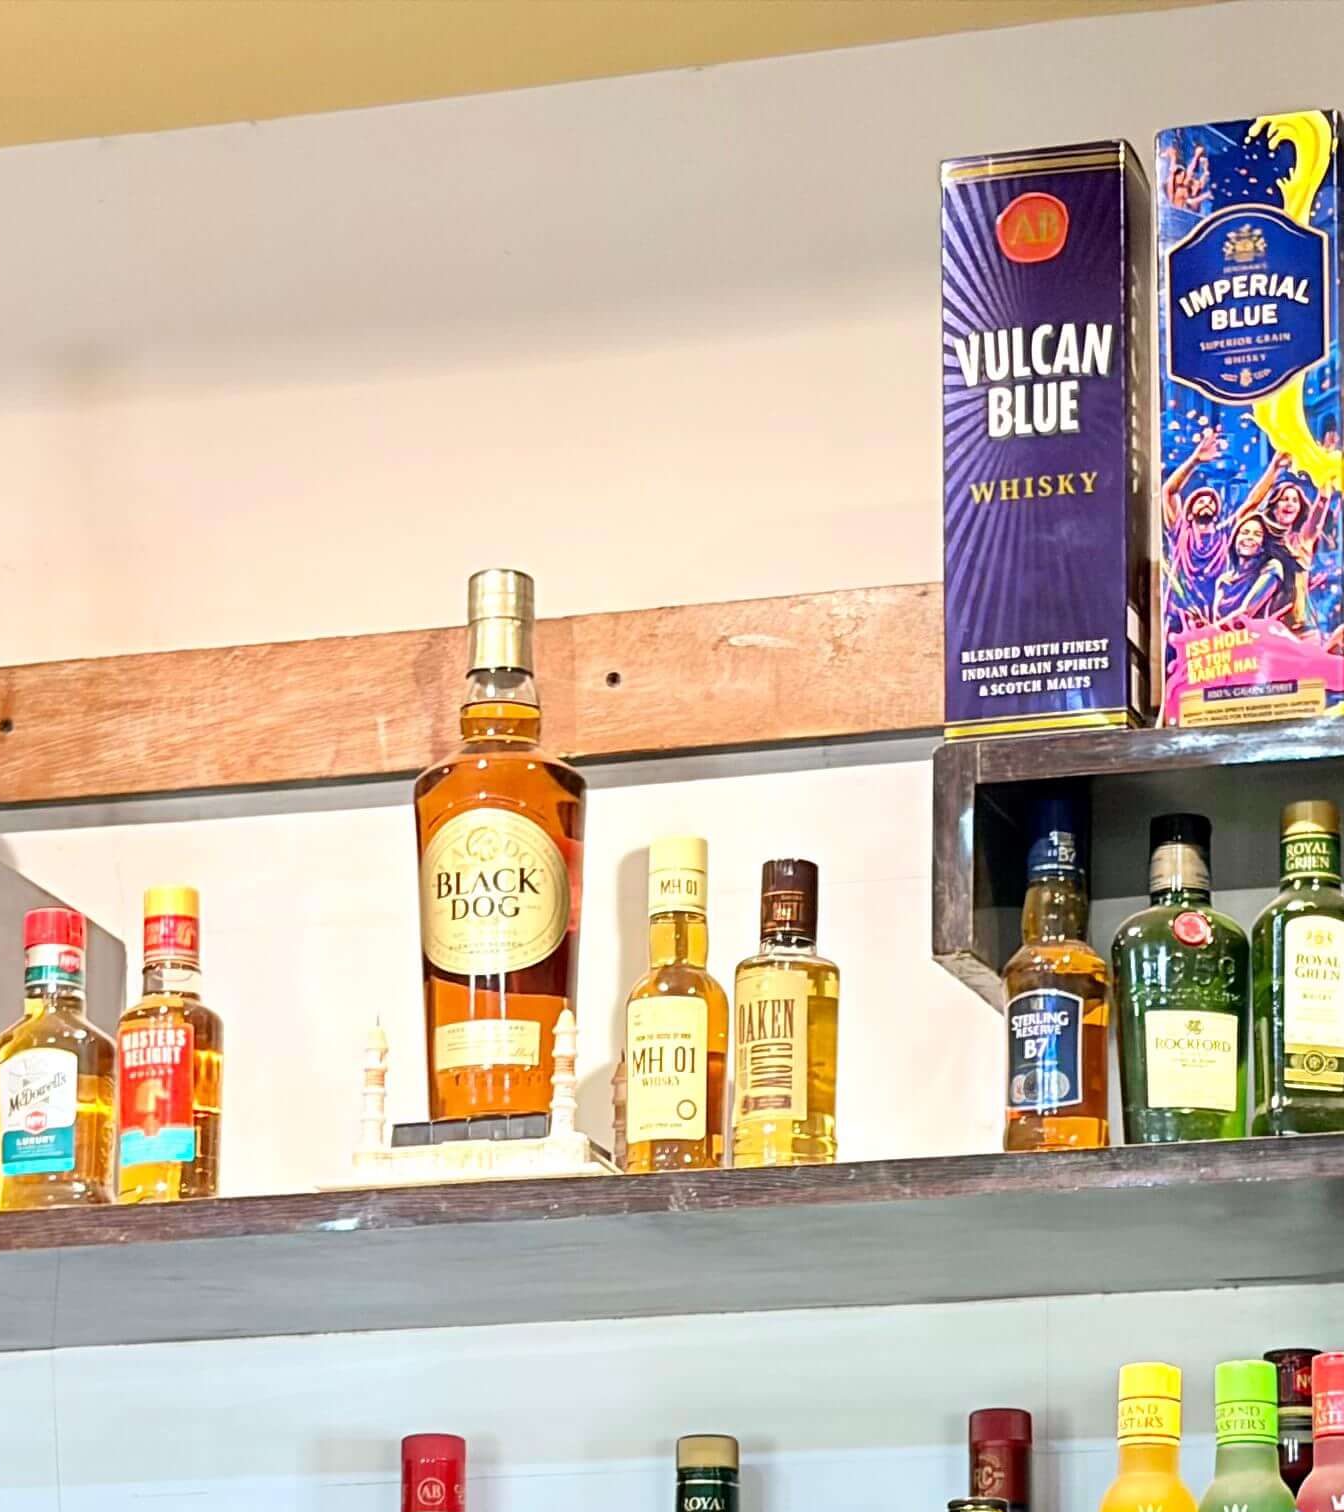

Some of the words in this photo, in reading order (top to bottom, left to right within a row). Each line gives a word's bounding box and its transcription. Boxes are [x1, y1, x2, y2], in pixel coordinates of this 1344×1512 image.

[1179, 274, 1310, 318] IMPERIAL
[1211, 303, 1279, 331] BLUE
[954, 322, 1113, 388] VULCAN
[987, 380, 1081, 438] BLUE
[969, 471, 1098, 505] WHISKY
[961, 645, 1020, 664] BLENDED
[1023, 641, 1060, 658] WITH
[1062, 638, 1109, 654] FINEST
[961, 664, 1008, 681] INDIAN
[1010, 661, 1052, 676] GRAIN
[1056, 657, 1109, 673] SPIRITS
[991, 679, 1042, 696] SCOTCH
[1047, 675, 1091, 691] MALTS
[1057, 847, 1077, 863] B7
[1286, 841, 1330, 858] ROYAL
[1285, 855, 1330, 871] GREEN
[437, 868, 540, 900] BLACK
[660, 879, 681, 895] MH
[686, 879, 698, 896] 01
[452, 896, 520, 921] DOG
[1295, 953, 1341, 968] ROYAL
[1294, 966, 1341, 982] GREEN
[739, 998, 795, 1045] OAKEN
[1011, 1009, 1069, 1032] STERLING
[122, 1028, 186, 1050] MASTERS
[1015, 1024, 1062, 1039] RESERVE
[1023, 1038, 1048, 1059] B7
[1155, 1036, 1232, 1053] ROCKFORD
[124, 1048, 182, 1068] DELIGHT
[632, 1046, 665, 1077] MH
[674, 1045, 696, 1074] 01
[1119, 1415, 1164, 1430] ASTER'S
[421, 1487, 441, 1499] AB
